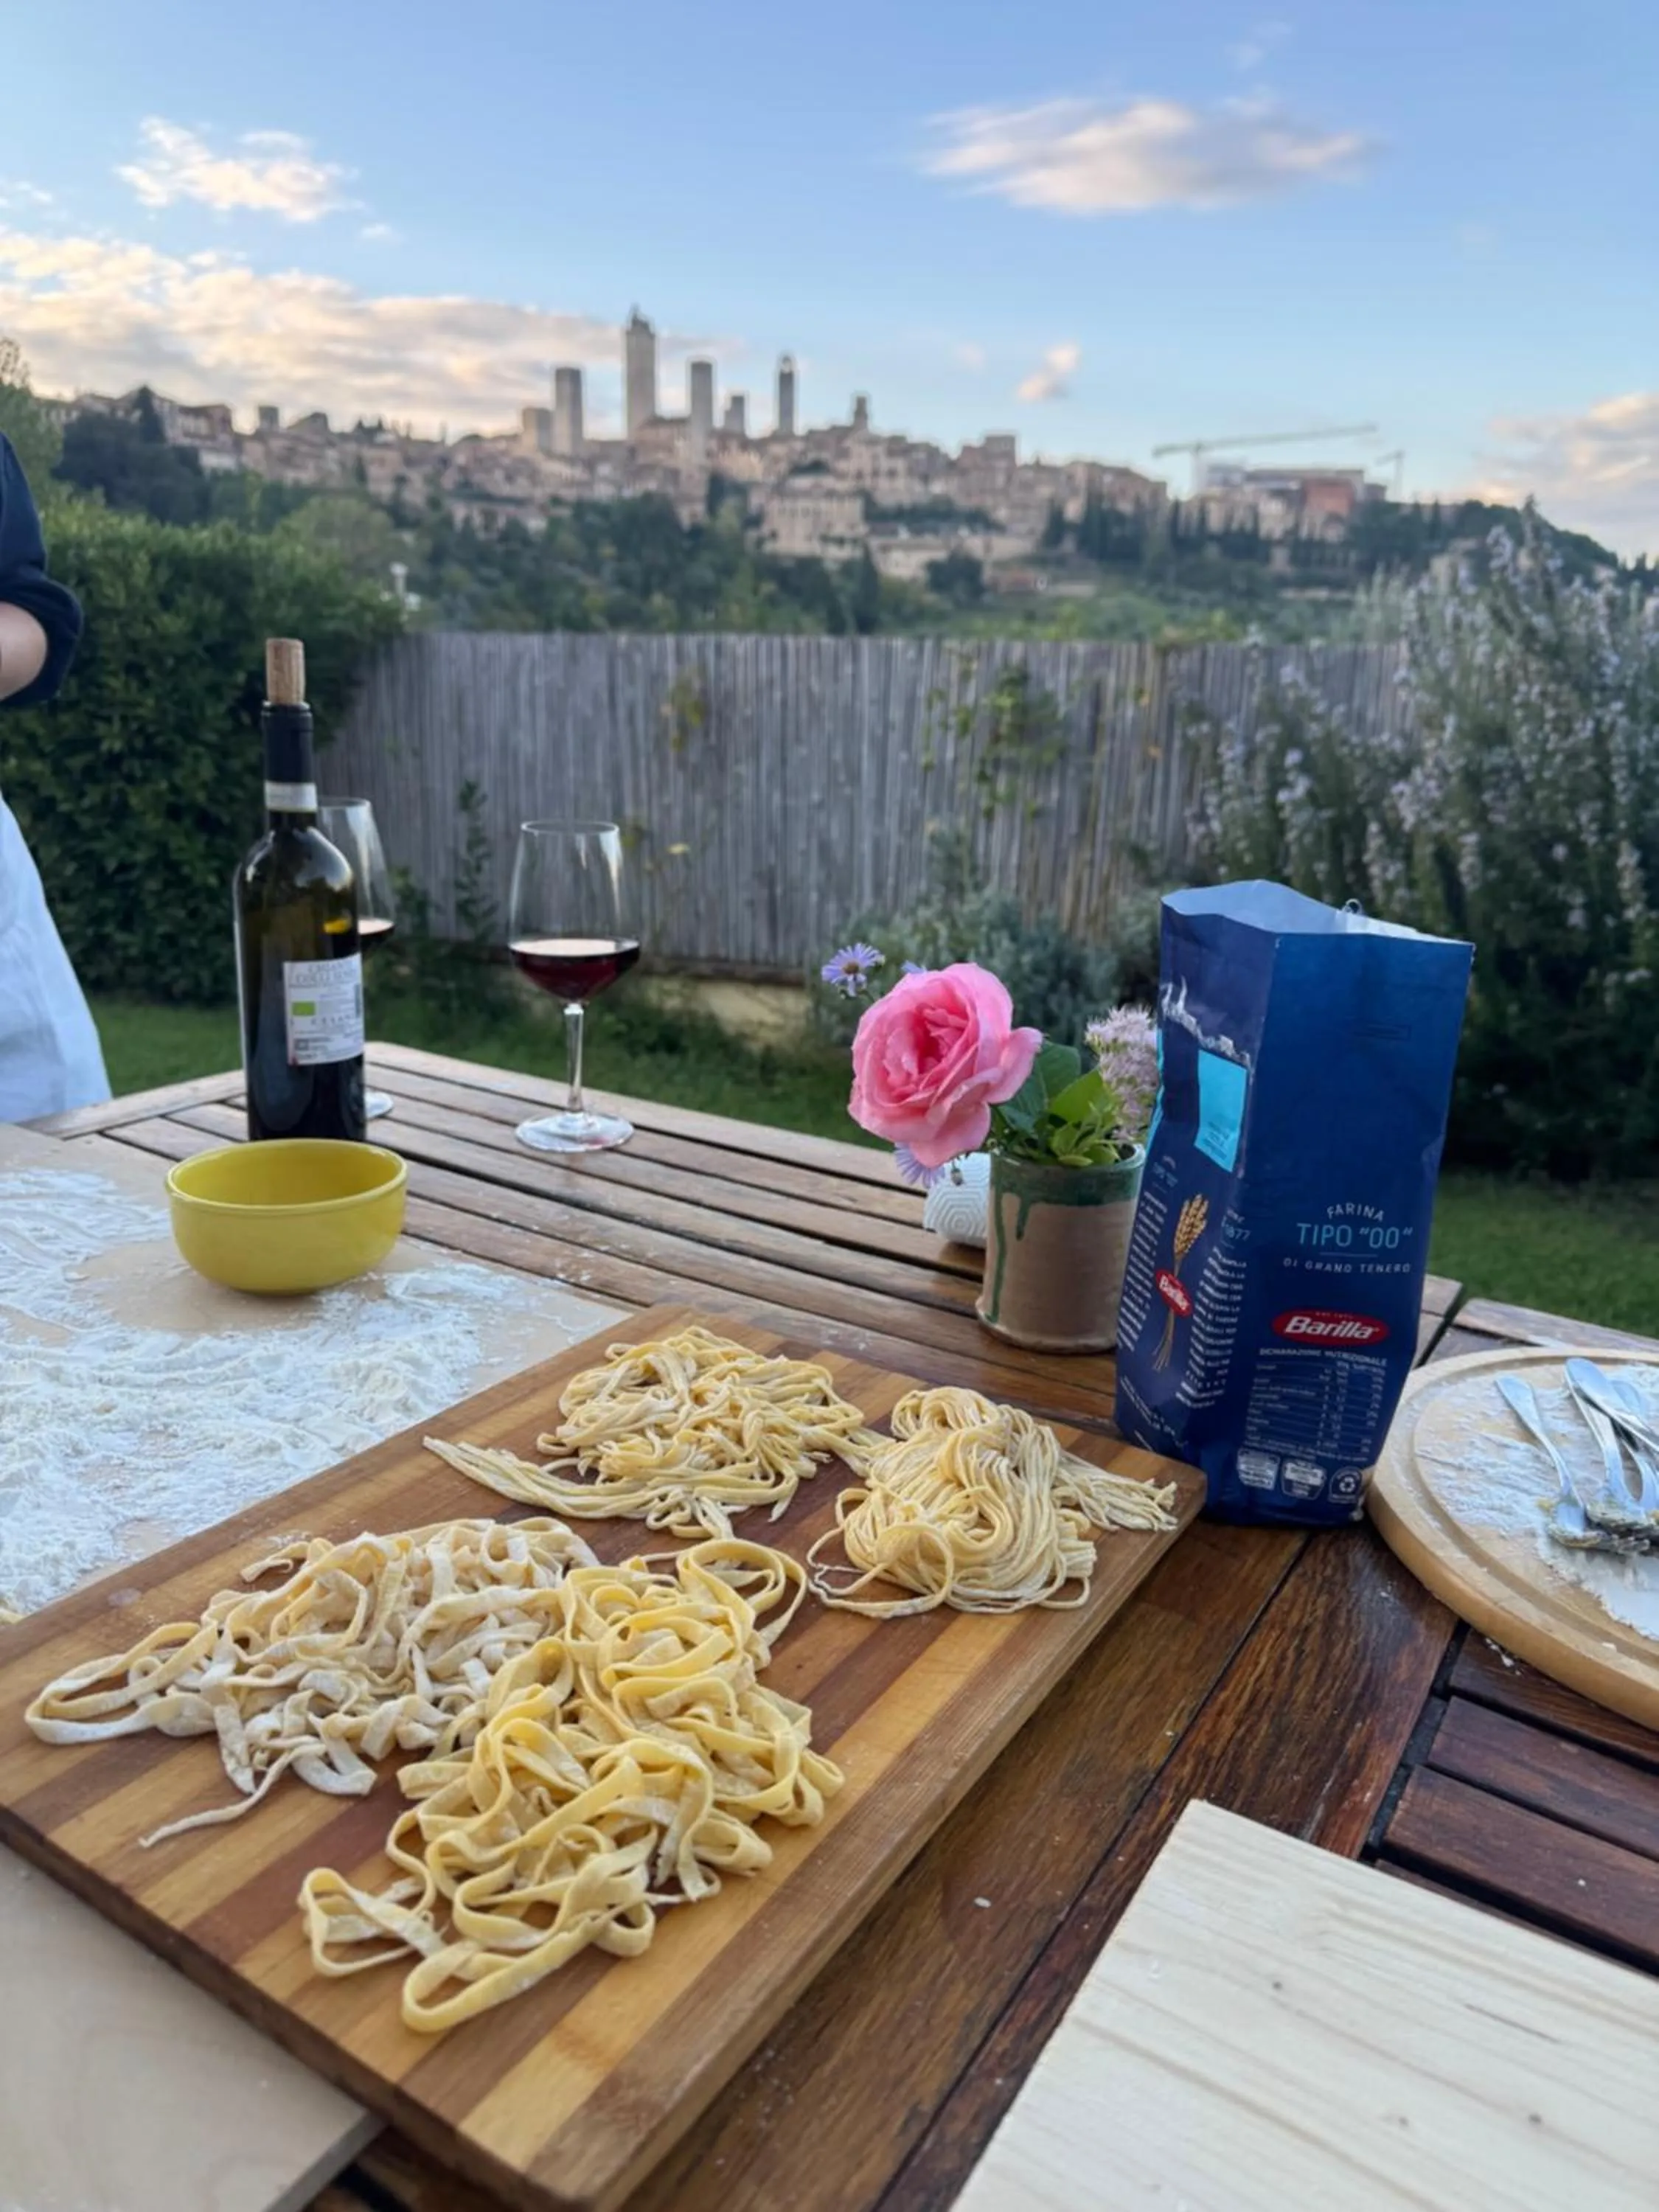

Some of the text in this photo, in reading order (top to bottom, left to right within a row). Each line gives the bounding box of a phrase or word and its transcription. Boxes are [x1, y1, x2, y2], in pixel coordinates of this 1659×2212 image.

[1327, 1203, 1385, 1222] FARINA
[1296, 1222, 1352, 1248] TIPO
[1283, 1257, 1411, 1273] DI GRANO TENERO
[1284, 1315, 1375, 1339] Barilla
